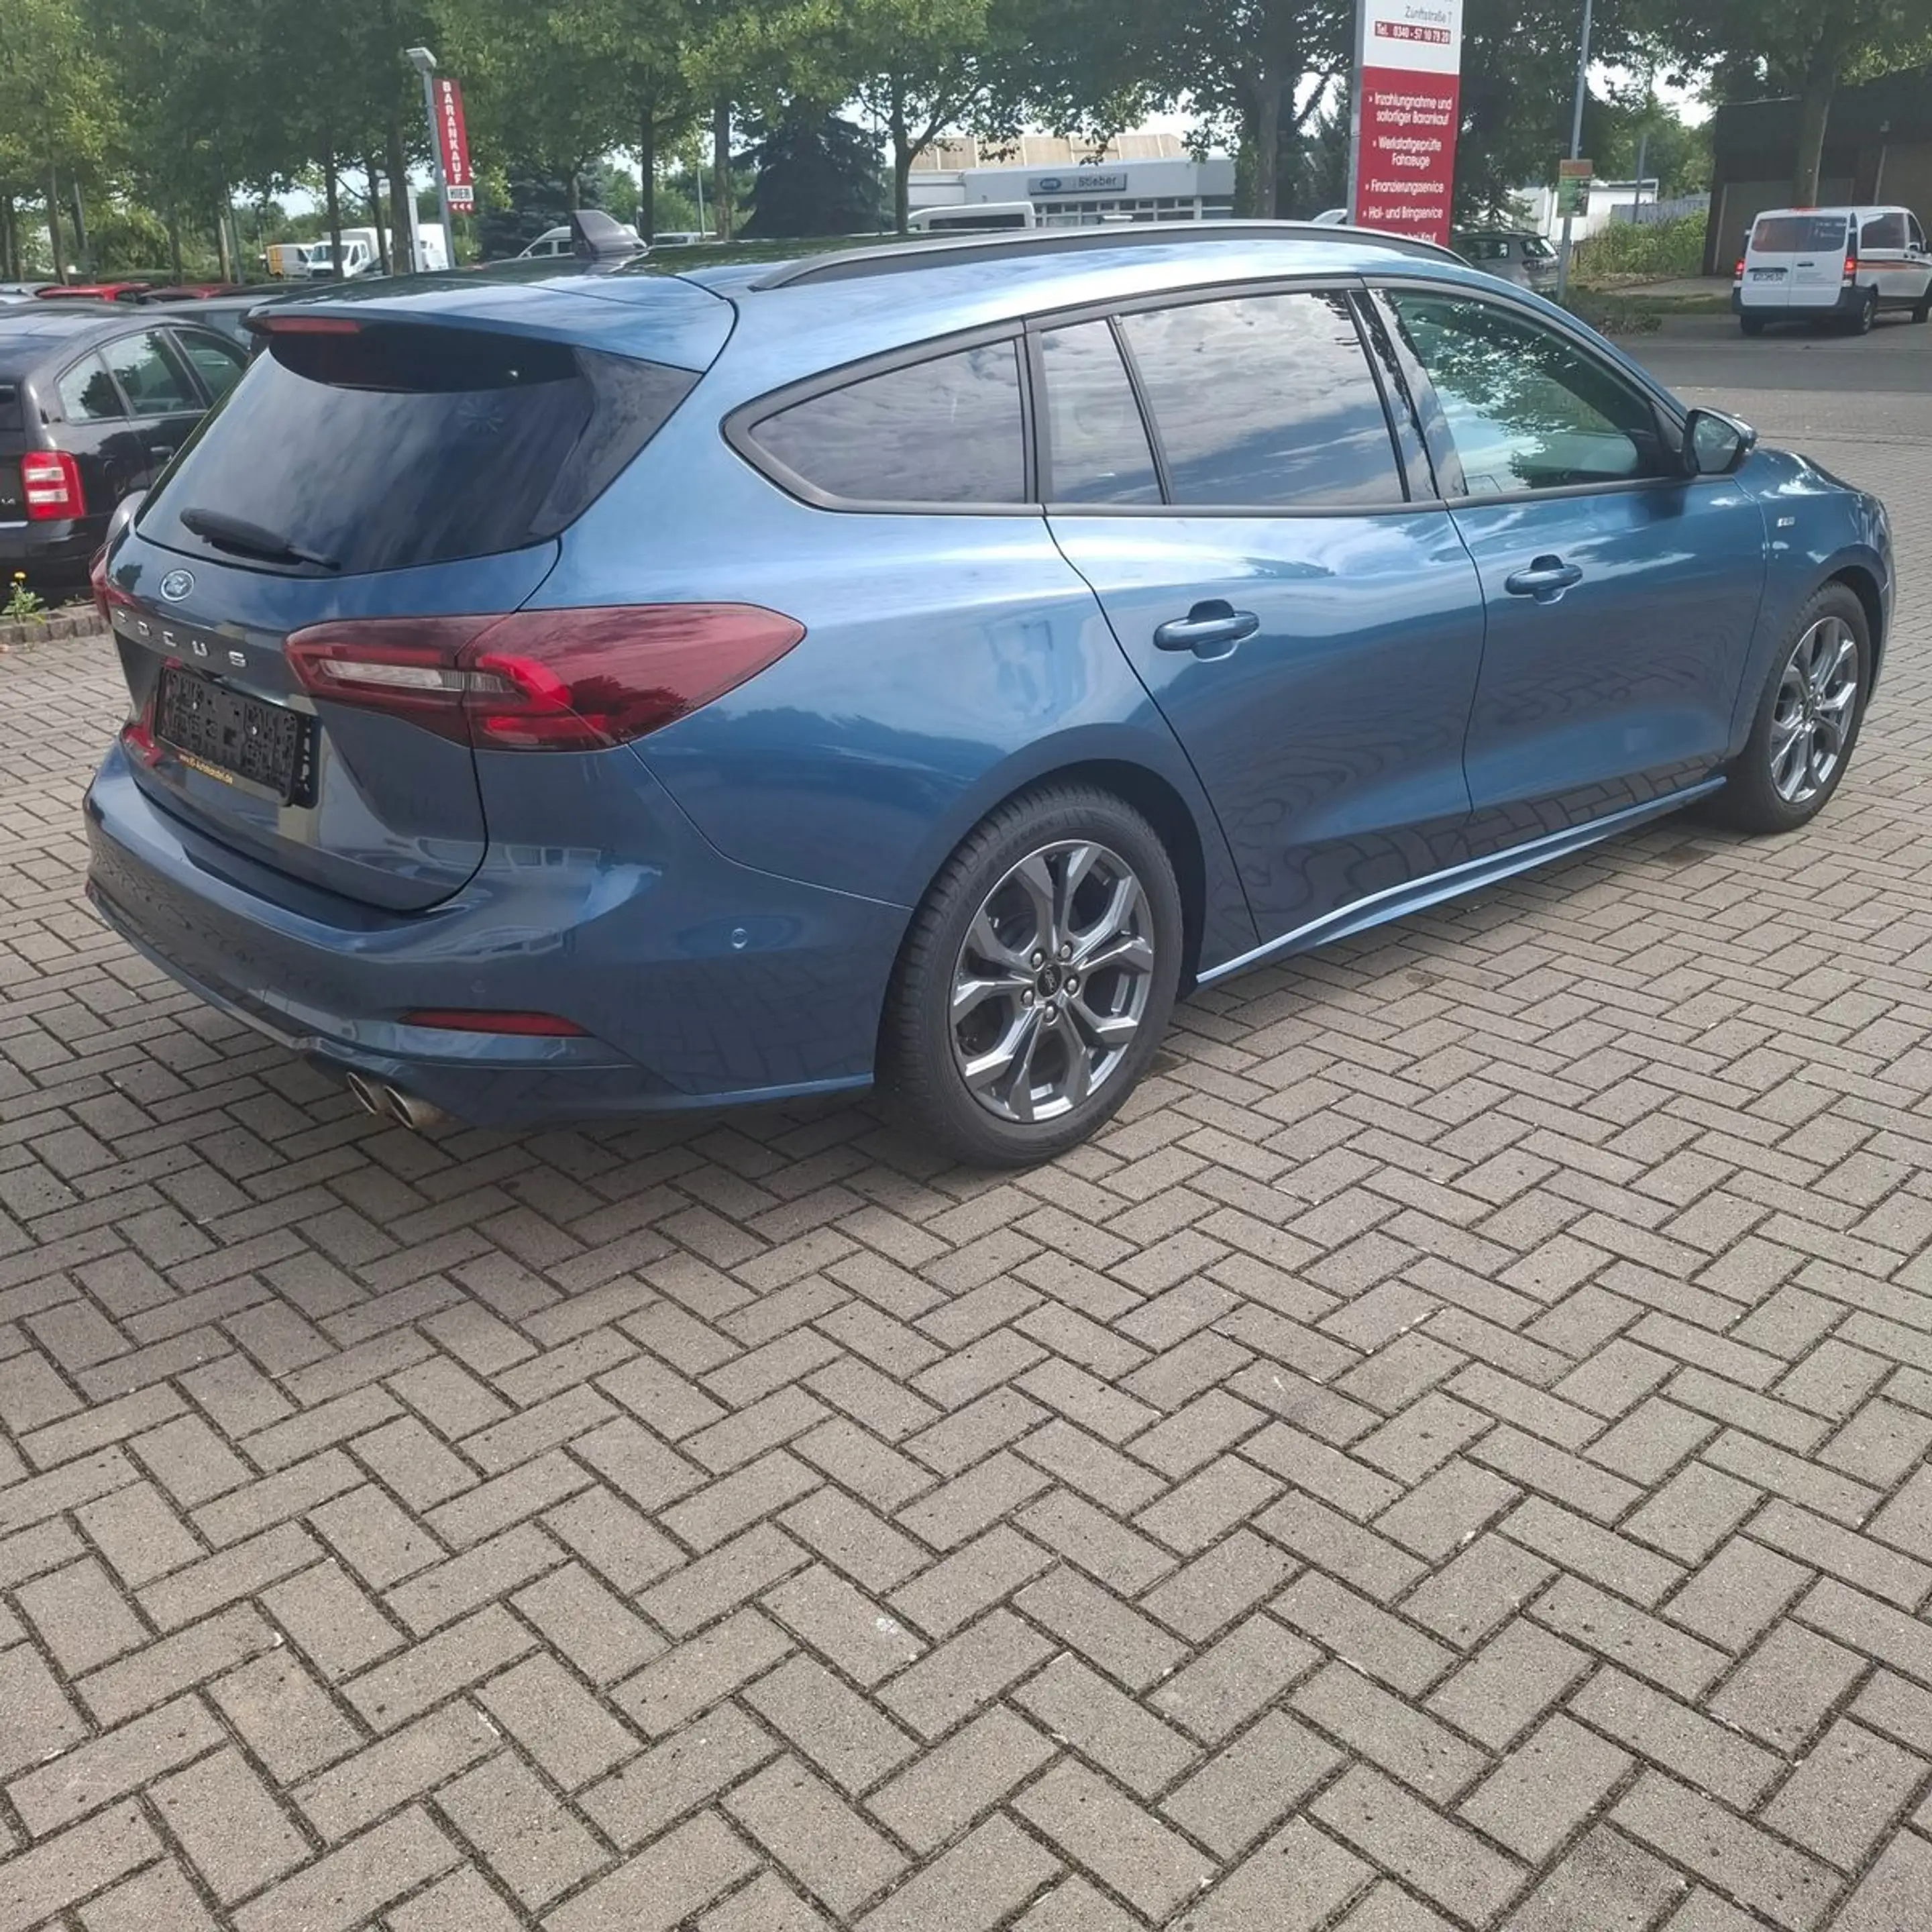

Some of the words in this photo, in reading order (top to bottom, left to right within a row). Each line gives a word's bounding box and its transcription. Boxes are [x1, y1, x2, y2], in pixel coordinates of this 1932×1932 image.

[1376, 23, 1389, 36] Tel.
[1375, 92, 1436, 110] Inzahlungnahme
[1438, 96, 1453, 110] und
[1377, 109, 1411, 126] sofortiger
[1412, 110, 1449, 125] Barankauf
[443, 80, 462, 184] BARANKAUF
[1392, 153, 1430, 170] Fahrzeuge
[1079, 175, 1116, 187] Stieber
[1371, 178, 1444, 195] Finanzierungsservice
[1368, 206, 1384, 219] Hol-
[1385, 207, 1401, 219] und
[1402, 206, 1444, 222] Bringservice
